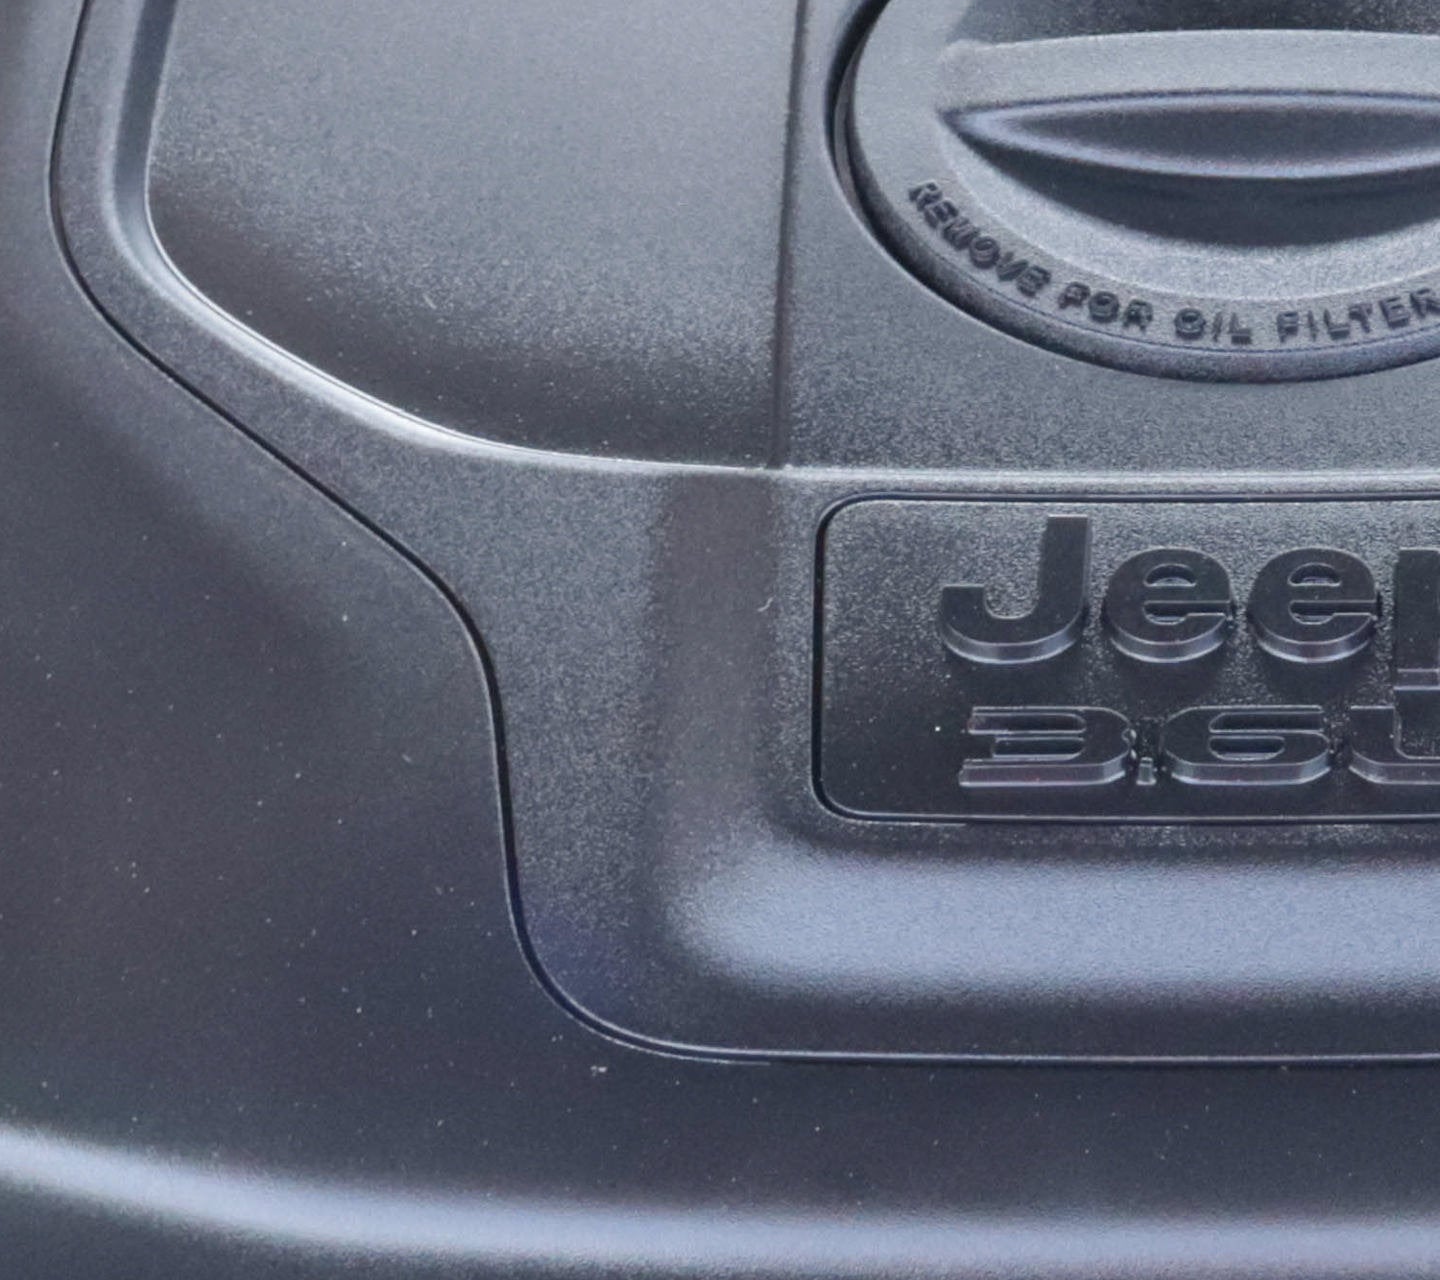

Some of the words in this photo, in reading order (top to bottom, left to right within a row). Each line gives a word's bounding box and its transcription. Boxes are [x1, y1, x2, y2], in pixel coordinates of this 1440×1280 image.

[910, 181, 1051, 297] REMOVE
[1060, 282, 1154, 333] FOR
[1175, 308, 1252, 345] OIL
